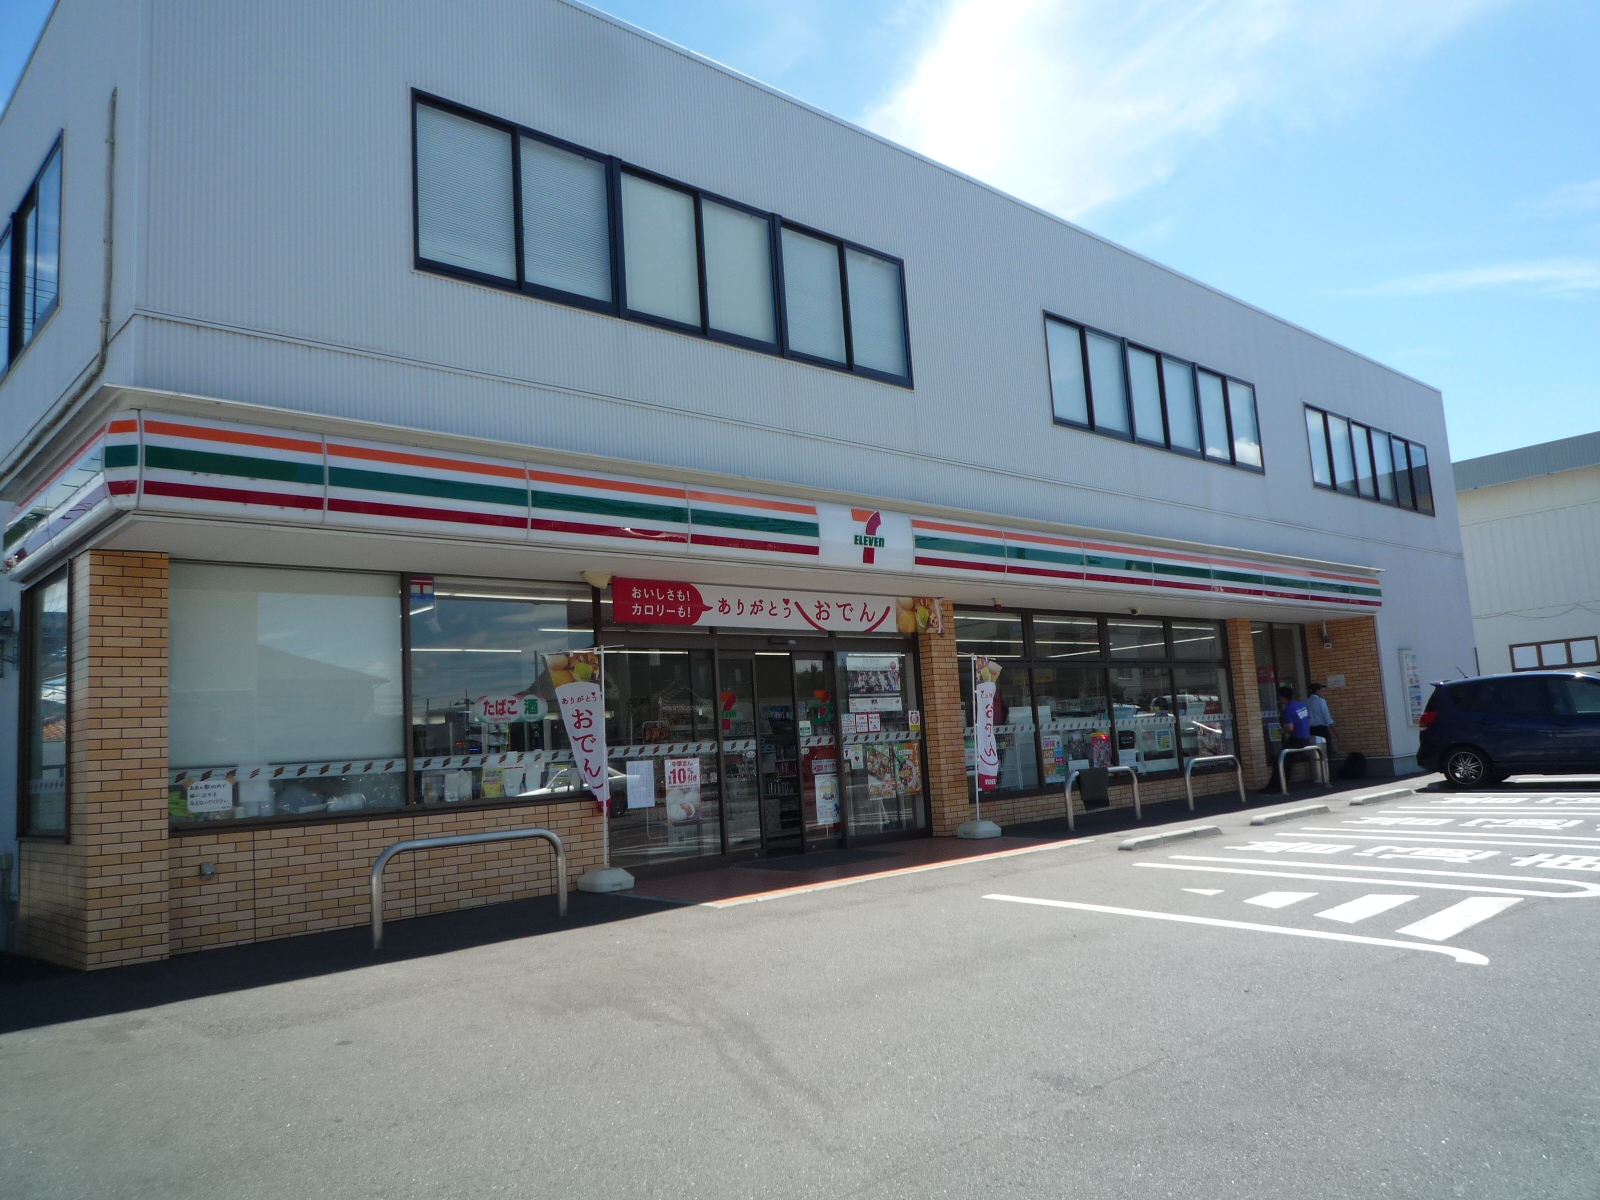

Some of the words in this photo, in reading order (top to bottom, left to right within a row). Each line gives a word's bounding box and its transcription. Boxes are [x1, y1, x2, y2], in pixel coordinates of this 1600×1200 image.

[717, 598, 792, 618] ありがとう
[814, 600, 876, 622] おでん
[483, 699, 518, 716] たばこ
[523, 699, 539, 715] 酒
[562, 695, 597, 705] ありがとう
[571, 709, 602, 777] おでん
